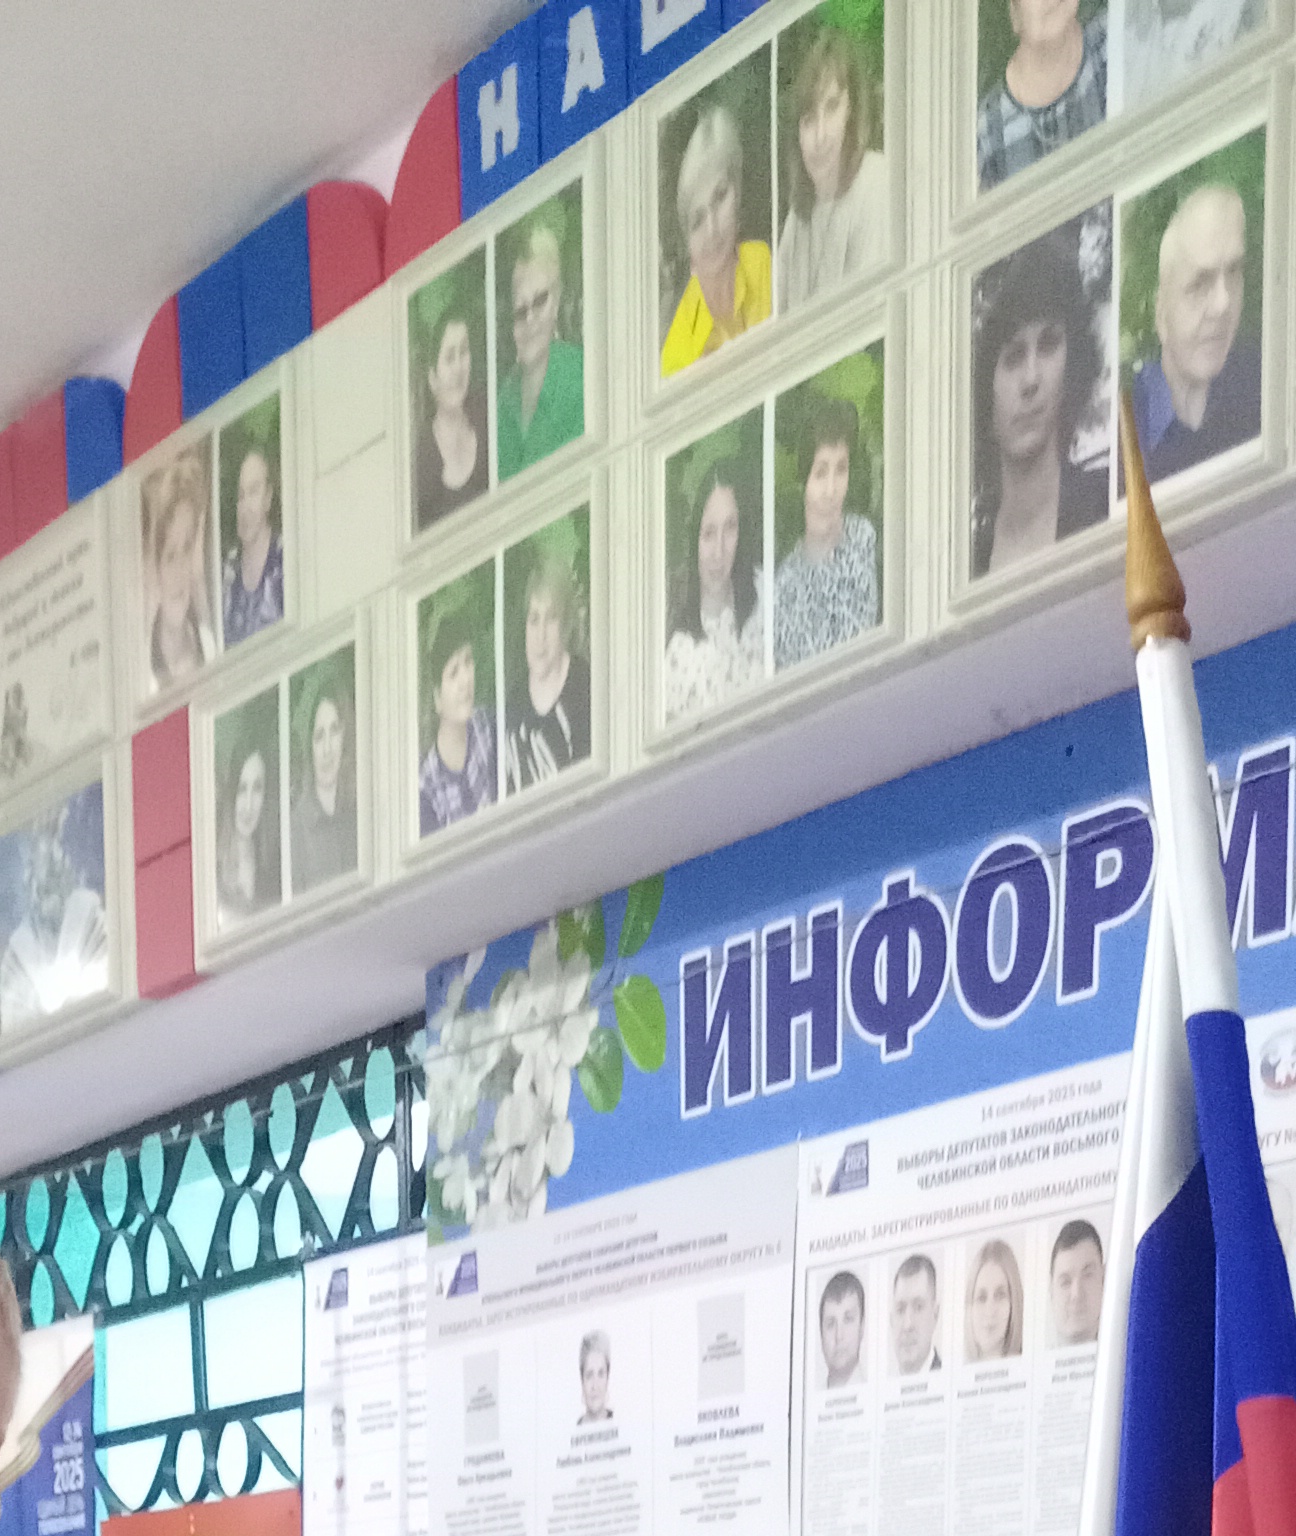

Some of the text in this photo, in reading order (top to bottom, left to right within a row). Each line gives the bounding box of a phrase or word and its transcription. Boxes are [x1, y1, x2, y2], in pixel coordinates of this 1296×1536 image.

[996, 1092, 1045, 1119] сентября
[1048, 1083, 1075, 1105] 2025
[897, 1146, 945, 1174] ВЫБОРЫ
[946, 1132, 1007, 1163] ДЕПУТАТОВ
[917, 1128, 1120, 1191] ЧЕЛЯБИНСКОЙ ОБЛАСТИ ВОСЬМОГО
